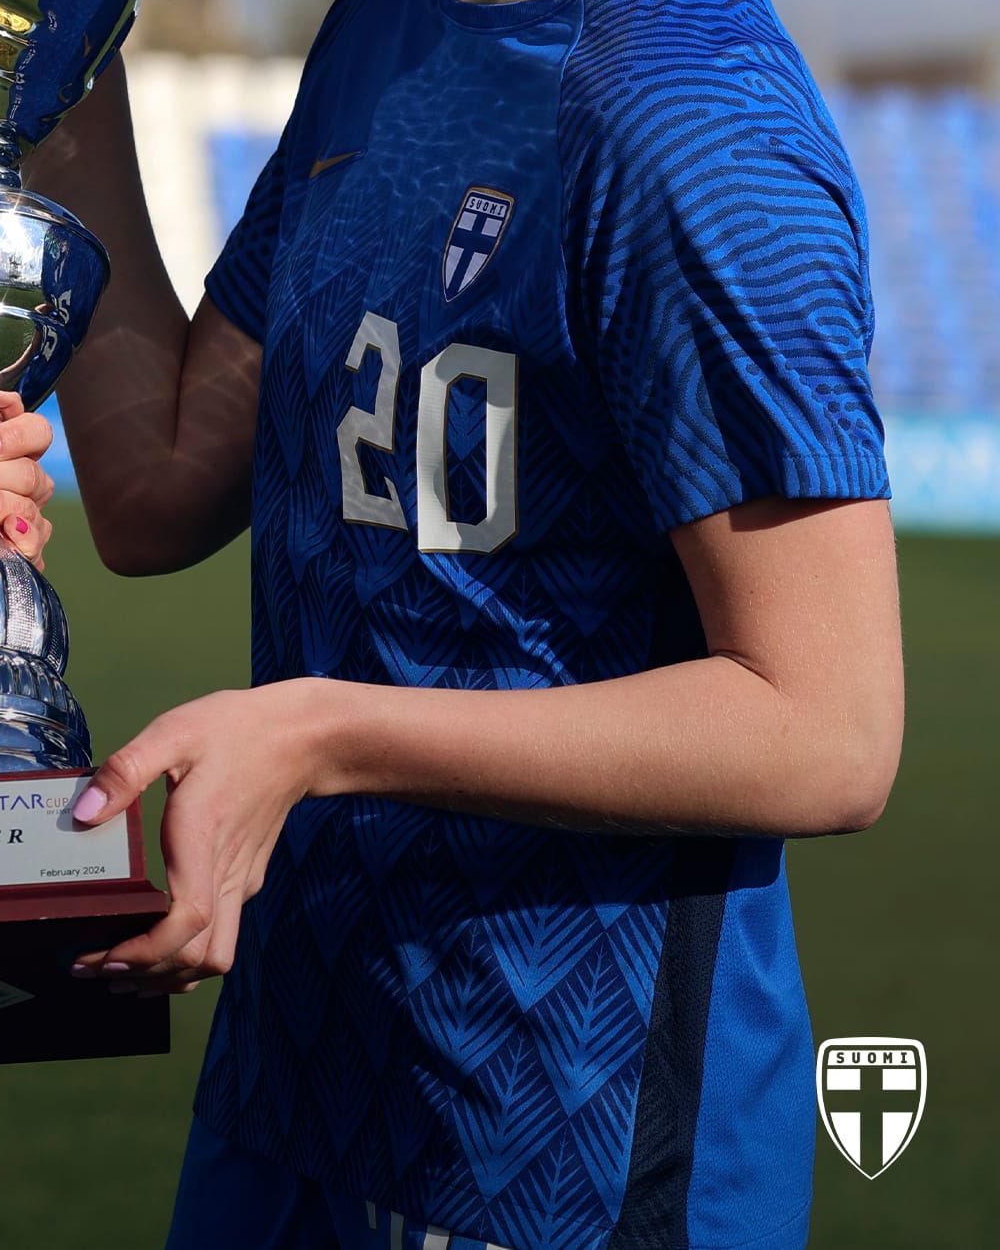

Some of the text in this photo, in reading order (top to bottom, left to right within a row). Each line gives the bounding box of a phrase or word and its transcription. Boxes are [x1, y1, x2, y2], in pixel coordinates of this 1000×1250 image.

[469, 198, 504, 216] SUOMI
[336, 311, 519, 553] 20
[45, 797, 69, 808] CUP
[40, 866, 105, 877] February 2024
